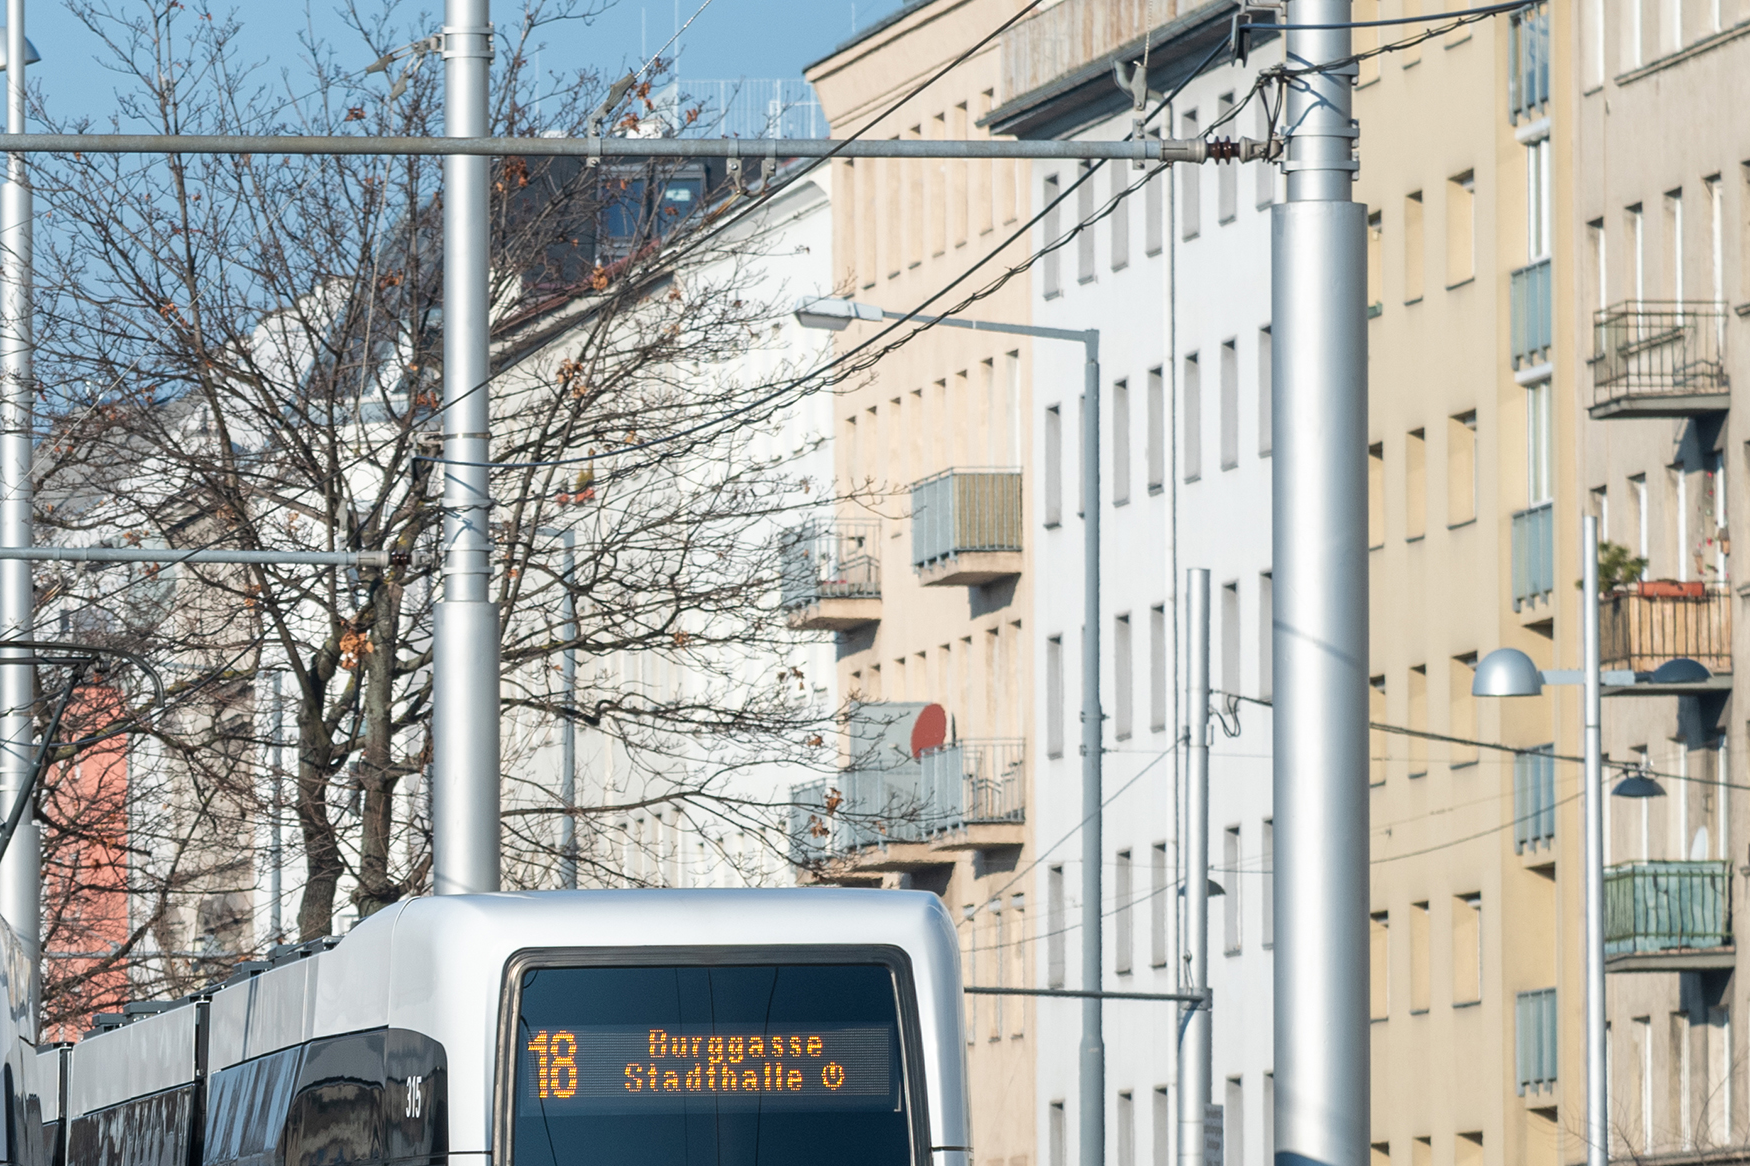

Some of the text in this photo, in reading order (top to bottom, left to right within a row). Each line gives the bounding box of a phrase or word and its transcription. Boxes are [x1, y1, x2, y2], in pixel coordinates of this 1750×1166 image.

[528, 1029, 823, 1098] 18 Burggasse
[624, 1062, 803, 1092] Stadthalle
[405, 1075, 422, 1118] 315
